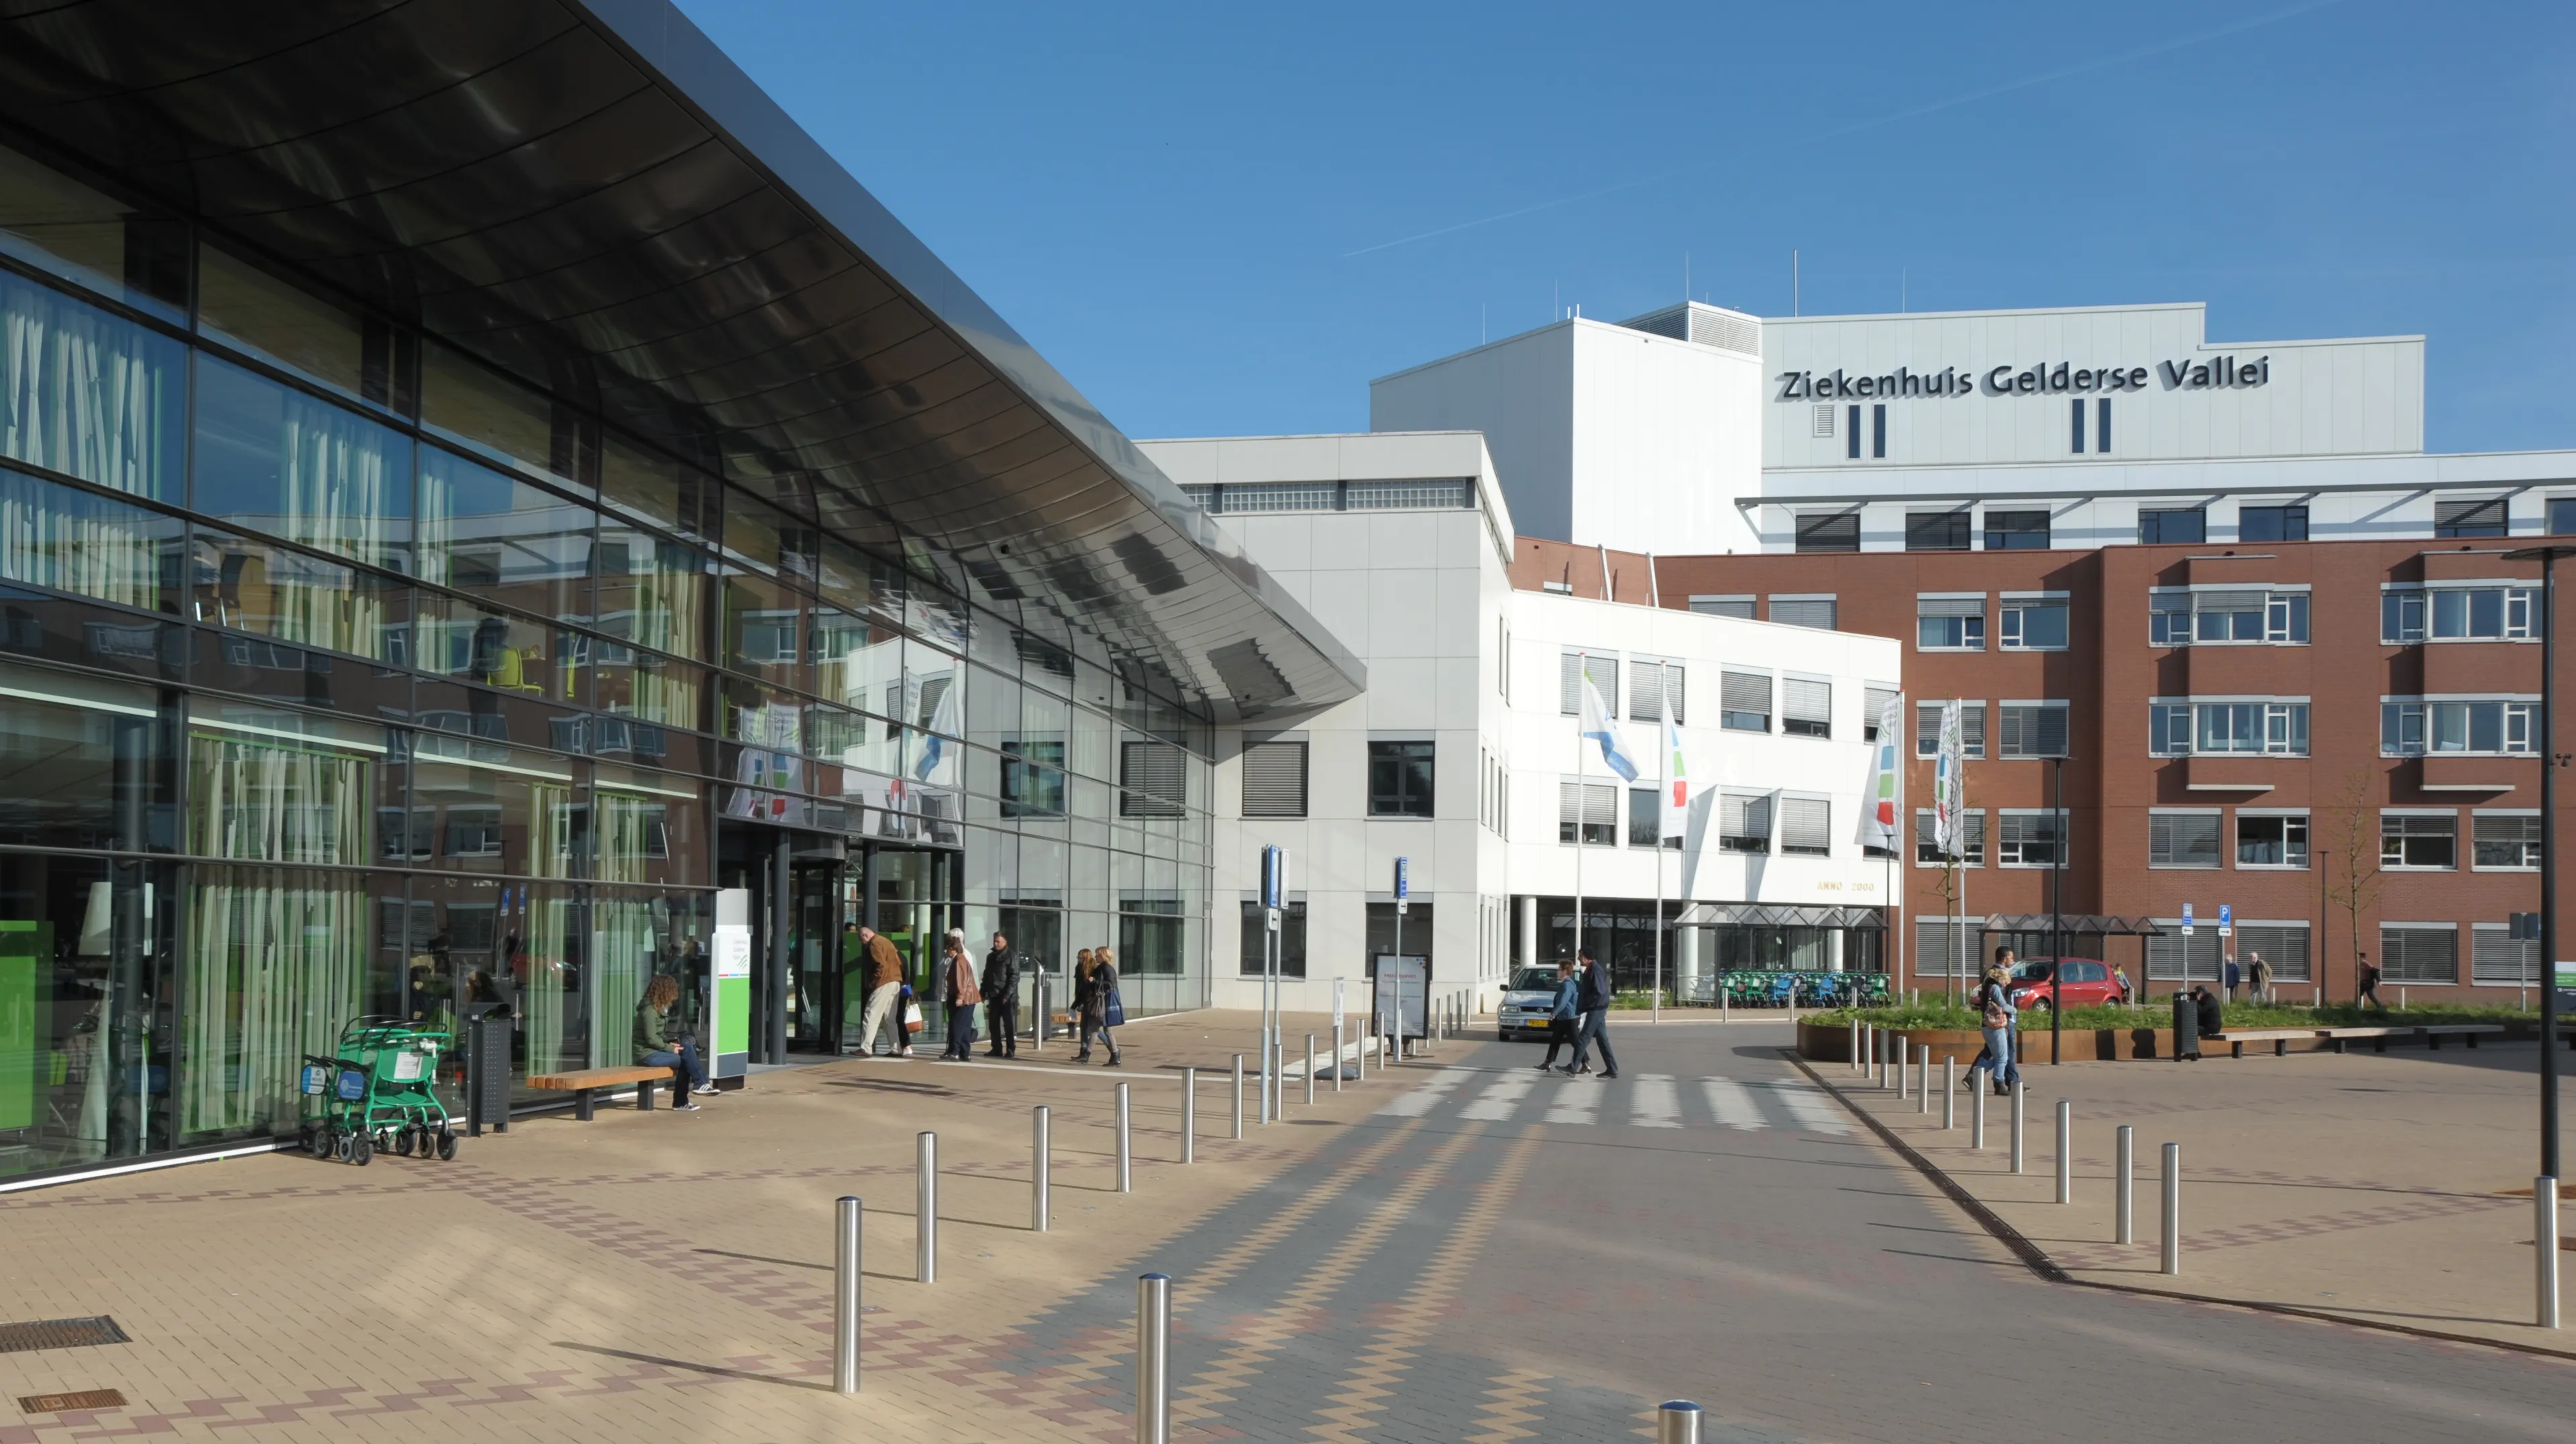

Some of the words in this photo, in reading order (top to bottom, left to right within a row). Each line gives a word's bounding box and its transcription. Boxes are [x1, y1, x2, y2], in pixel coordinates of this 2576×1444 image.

[1782, 366, 1974, 399] Ziekenhuis
[1988, 360, 2149, 394] Gelderse
[2165, 355, 2269, 388] Vallei
[1817, 881, 1843, 891] ANNO
[1851, 882, 1874, 891] 2000
[2222, 907, 2229, 919] P
